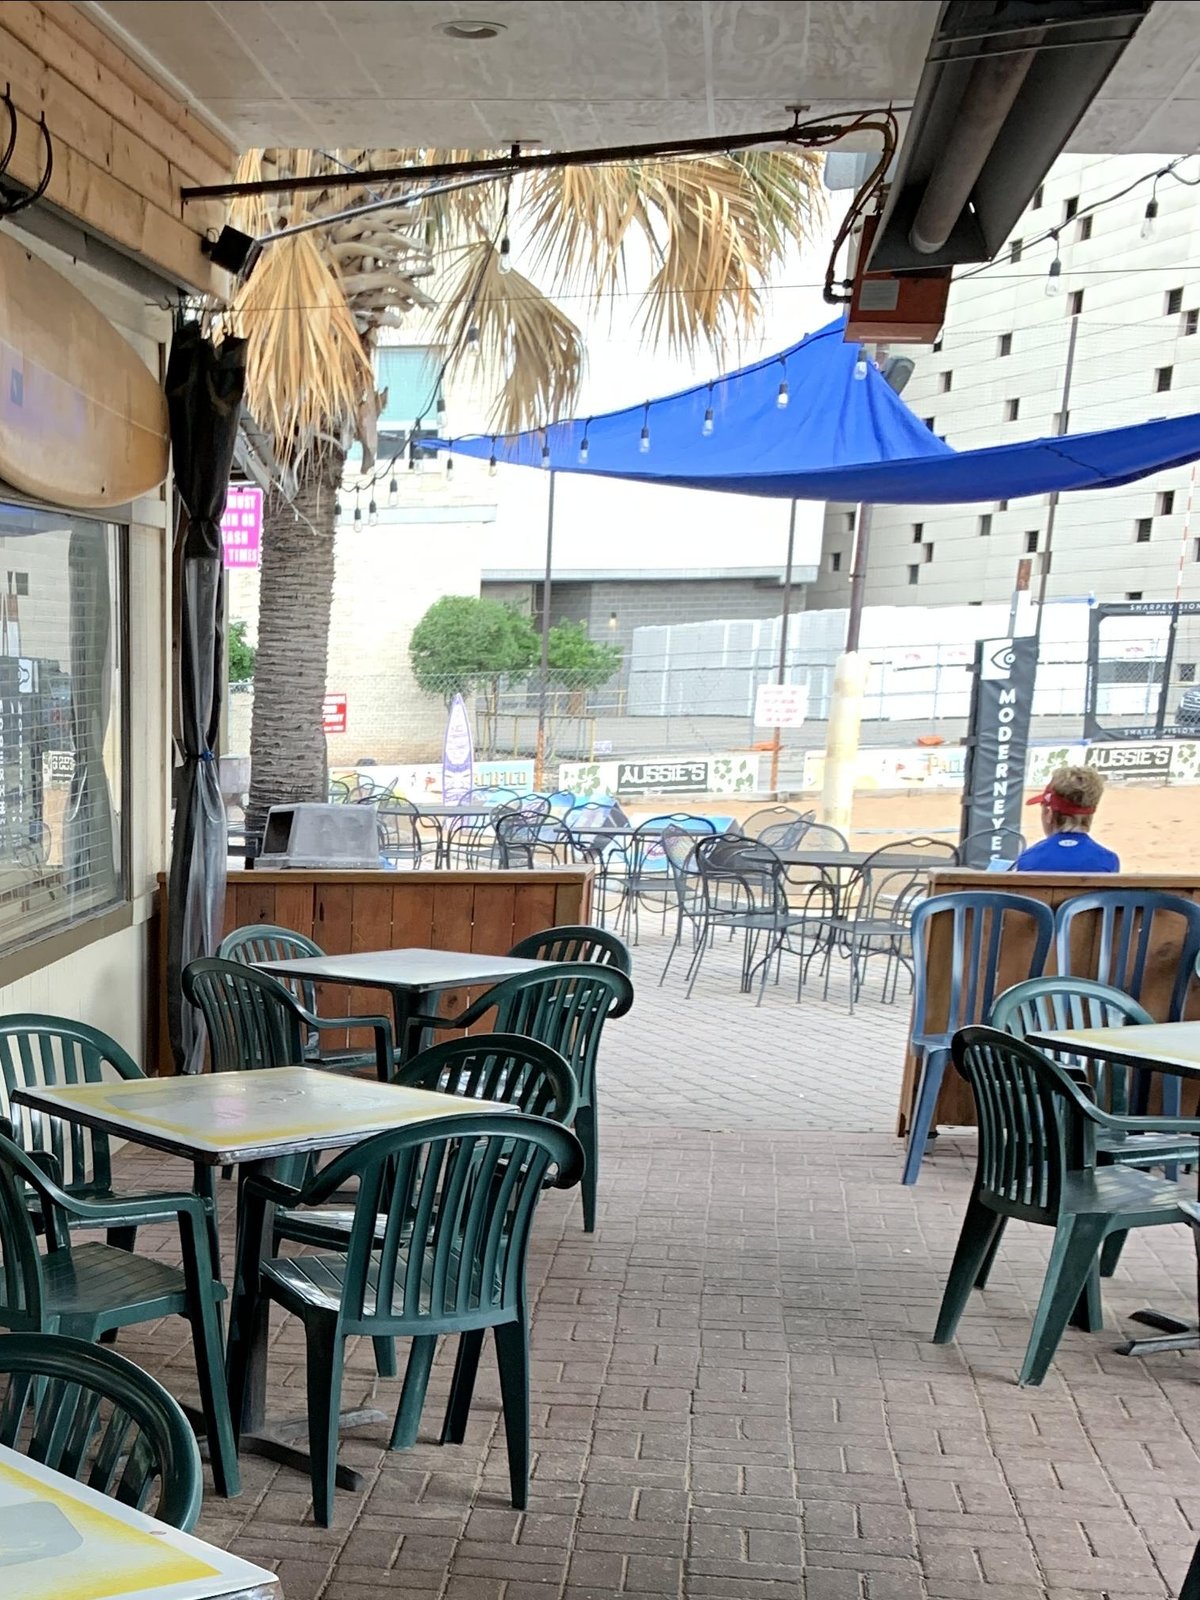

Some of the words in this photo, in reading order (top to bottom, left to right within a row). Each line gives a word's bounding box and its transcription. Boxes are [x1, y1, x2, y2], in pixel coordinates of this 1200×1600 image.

[222, 530, 248, 545] EASH
[1087, 747, 1170, 768] AUSSIE'S
[620, 763, 706, 784] AUSSIE'S
